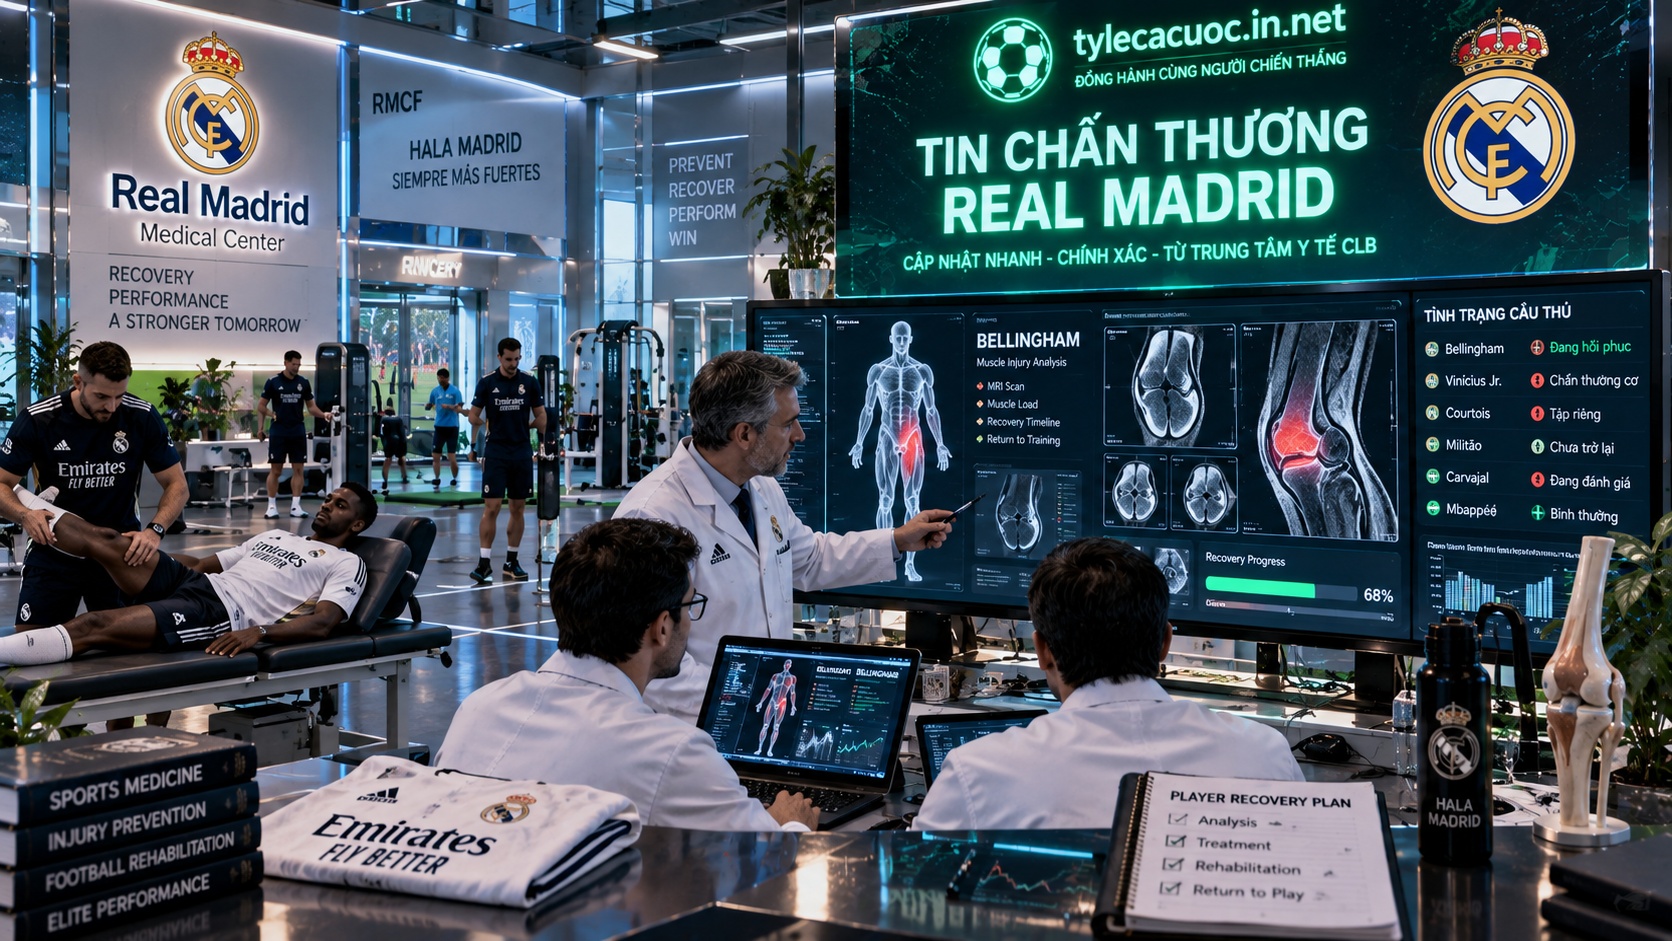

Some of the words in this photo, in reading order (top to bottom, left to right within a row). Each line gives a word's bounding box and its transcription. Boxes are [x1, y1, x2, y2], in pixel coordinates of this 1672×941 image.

[1073, 3, 1346, 62] tylecacuoc.in.net
[1159, 63, 1197, 80] CÙNG
[1201, 58, 1246, 77] NGƯỜI
[372, 90, 423, 115] RMCF
[409, 137, 453, 160] HALA
[458, 131, 522, 156] MADRID
[916, 134, 987, 177] TIN
[1004, 112, 1137, 172] CHẤN
[1155, 106, 1369, 162] THƯƠNG
[669, 153, 734, 174] PREVENT
[392, 169, 448, 190] SIEMPRE
[452, 163, 480, 186] MÁS
[484, 163, 541, 184] FUERTES
[669, 178, 735, 199] RECOVER
[112, 173, 189, 215] Real
[201, 183, 309, 226] Madrid
[943, 181, 1084, 235] REAL
[1103, 166, 1334, 227] MADRID
[669, 203, 736, 223] PERFORM
[141, 222, 216, 247] Medical
[224, 229, 285, 252] Center
[669, 230, 697, 246] WIN
[903, 251, 934, 274] CẬP
[939, 249, 981, 273] NHẬT
[985, 250, 1042, 268] NHANH
[1057, 244, 1109, 265] CHÍNH
[1113, 242, 1147, 264] XÁC
[1163, 241, 1186, 262] TỪ
[1191, 242, 1249, 261] TRUNG
[1254, 236, 1292, 258] TÂM
[1297, 239, 1310, 256] Y
[1342, 236, 1377, 255] CLB
[109, 265, 194, 285] RECOVERY
[109, 289, 229, 309] PERFORMANCE
[109, 312, 120, 329] A
[126, 313, 210, 331] STRONGER
[214, 316, 302, 333] TOMORROW
[1424, 306, 1455, 322] TÌNH
[1459, 307, 1506, 325] TRẠNG
[977, 331, 1080, 349] BELLINGHAM
[1549, 341, 1579, 356] Đang
[1445, 342, 1504, 357] Bellingham
[976, 357, 1005, 367] Muscle
[1008, 357, 1031, 369] Injury
[1033, 357, 1067, 369] Analysis
[987, 381, 1003, 391] MRI
[1005, 381, 1025, 391] Scan
[1489, 374, 1502, 387] Jr.
[1624, 376, 1639, 386] cơ
[987, 399, 1016, 409] Muscle
[1018, 399, 1039, 409] Load
[1446, 407, 1491, 419] Courtois
[987, 416, 1024, 428] Recovery
[1026, 417, 1060, 427] Timeline
[987, 434, 1014, 444] Return
[1017, 435, 1025, 444] to
[1027, 434, 1061, 447] Training
[1549, 441, 1579, 453] Chưa
[1601, 442, 1614, 456] lại
[58, 460, 126, 477] Emirates
[84, 475, 115, 489] BETTER
[1446, 471, 1489, 486] Carvajal
[1550, 474, 1579, 490] Đang
[1582, 475, 1610, 488] đánh
[1614, 476, 1631, 492] giá
[1205, 552, 1245, 566] Recovery
[1247, 554, 1286, 568] Progress
[1364, 588, 1394, 603] 68%
[50, 780, 119, 811] SPORTS
[124, 764, 203, 796] MEDICINE
[1170, 790, 1225, 804] PLAYER
[1230, 794, 1308, 807] RECOVERY
[1312, 797, 1351, 809] PLAN
[1436, 797, 1473, 812] HALA
[48, 822, 108, 851] INJURY
[112, 801, 206, 837] PREVENTION
[1198, 816, 1257, 829] Analysis
[1428, 812, 1481, 828] MADRID
[312, 813, 497, 856] Emirates
[1197, 837, 1271, 851] Treatment
[45, 858, 126, 893] FOOTBALL
[129, 831, 235, 872] REHABILITATION
[319, 843, 369, 863] FLY
[361, 848, 449, 875] BETTER
[1195, 861, 1301, 875] Rehabilitation
[1193, 884, 1245, 898] Return
[1251, 886, 1266, 899] to
[1272, 887, 1305, 902] Play
[47, 904, 92, 933] ELITE
[97, 873, 210, 920] PERFORMANCE
